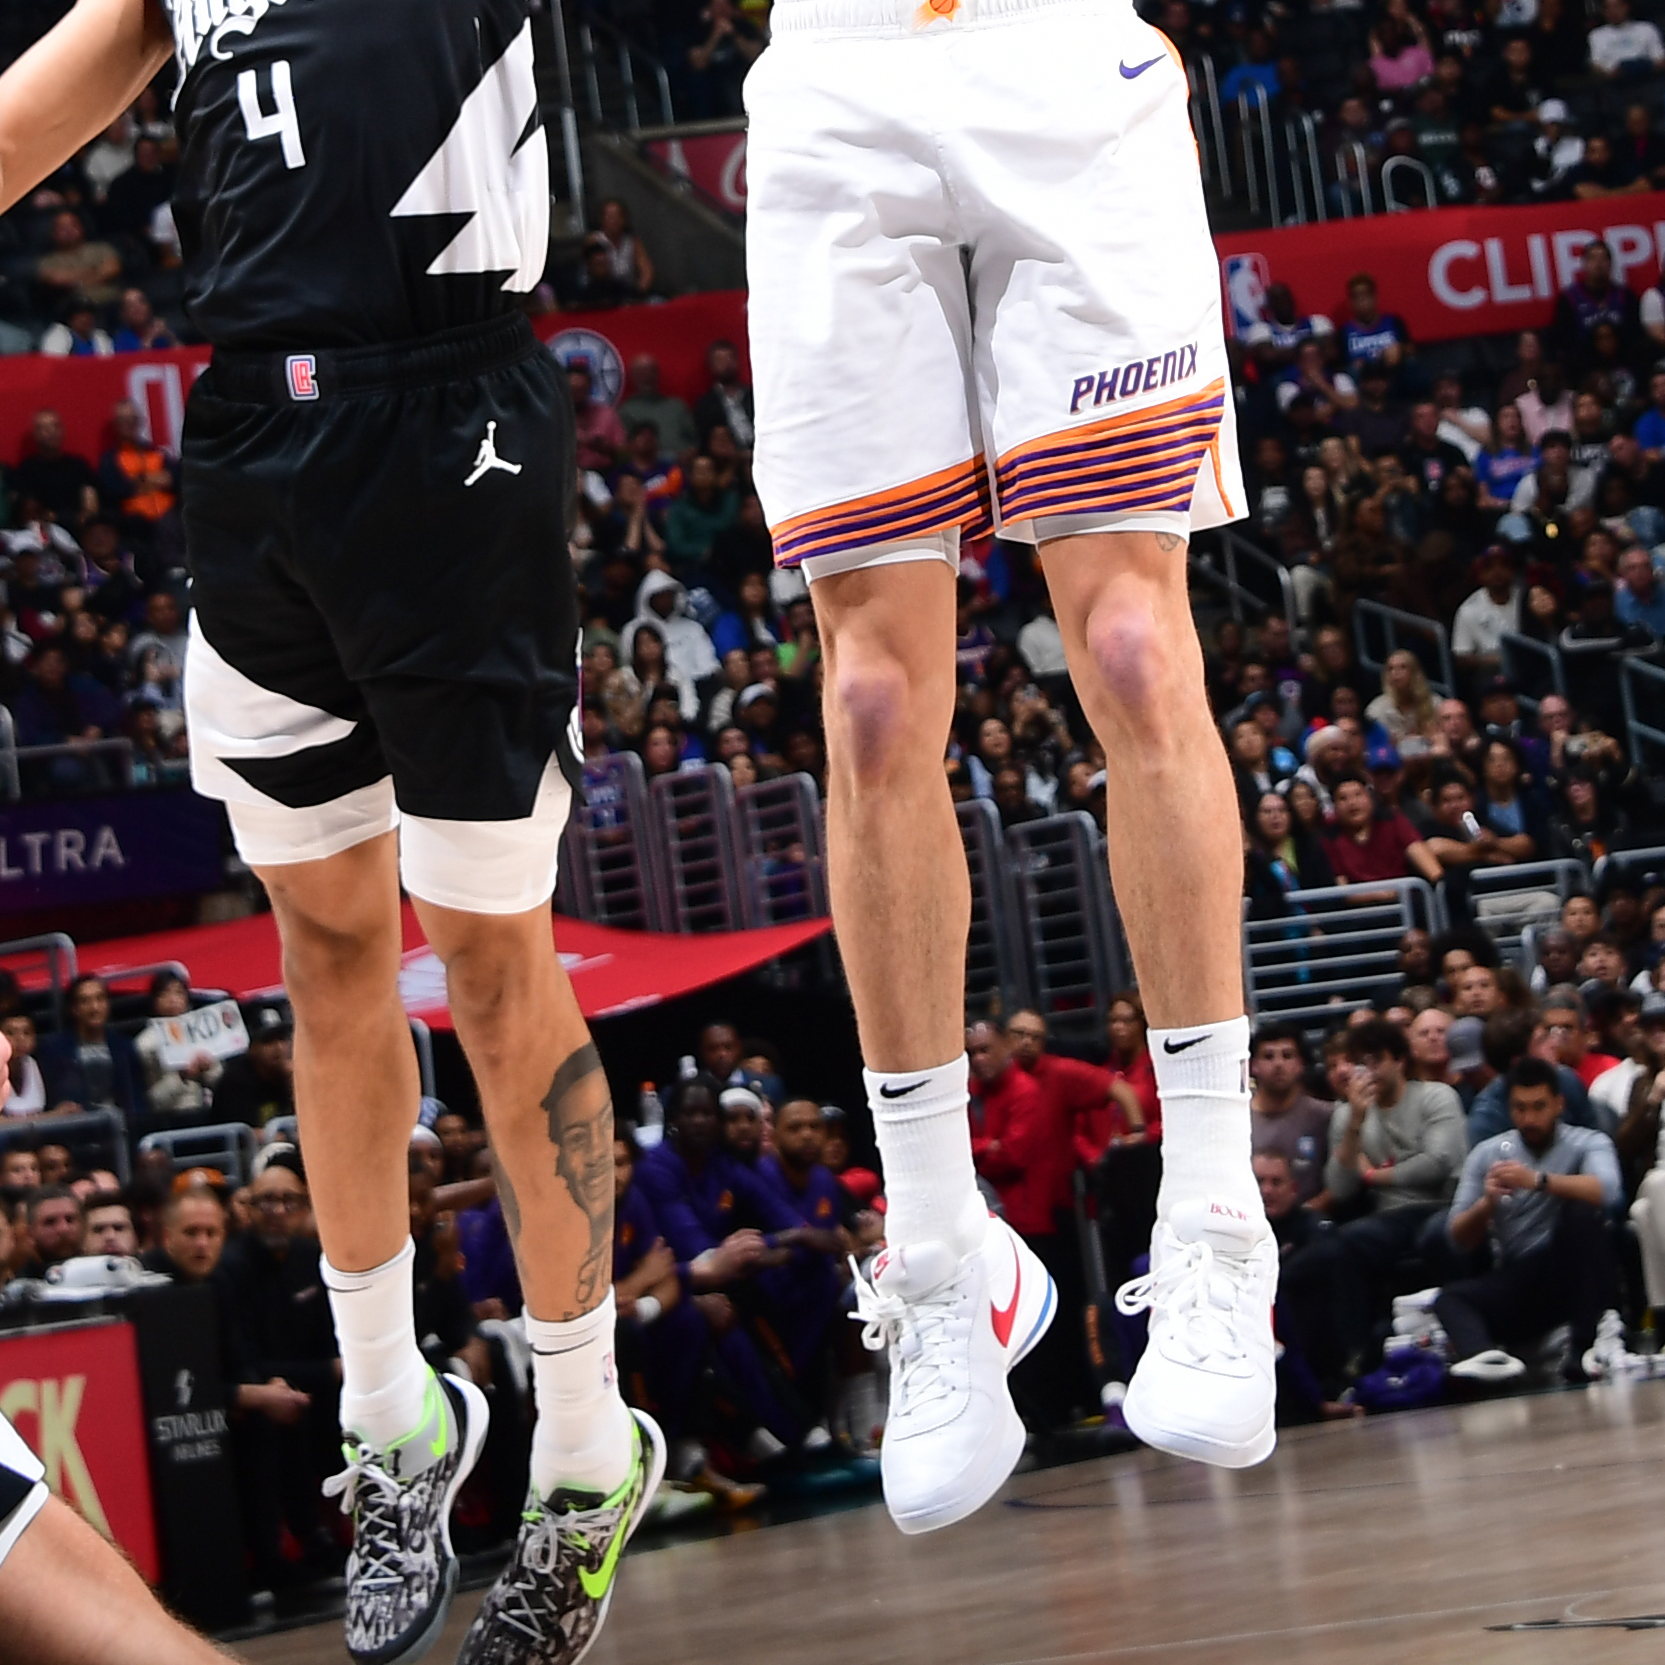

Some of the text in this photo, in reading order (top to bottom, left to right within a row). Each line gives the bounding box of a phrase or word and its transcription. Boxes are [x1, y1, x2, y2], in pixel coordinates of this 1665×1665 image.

[236, 57, 308, 170] 4
[1069, 339, 1200, 415] PHOENIX
[152, 1408, 230, 1443] STARLUX
